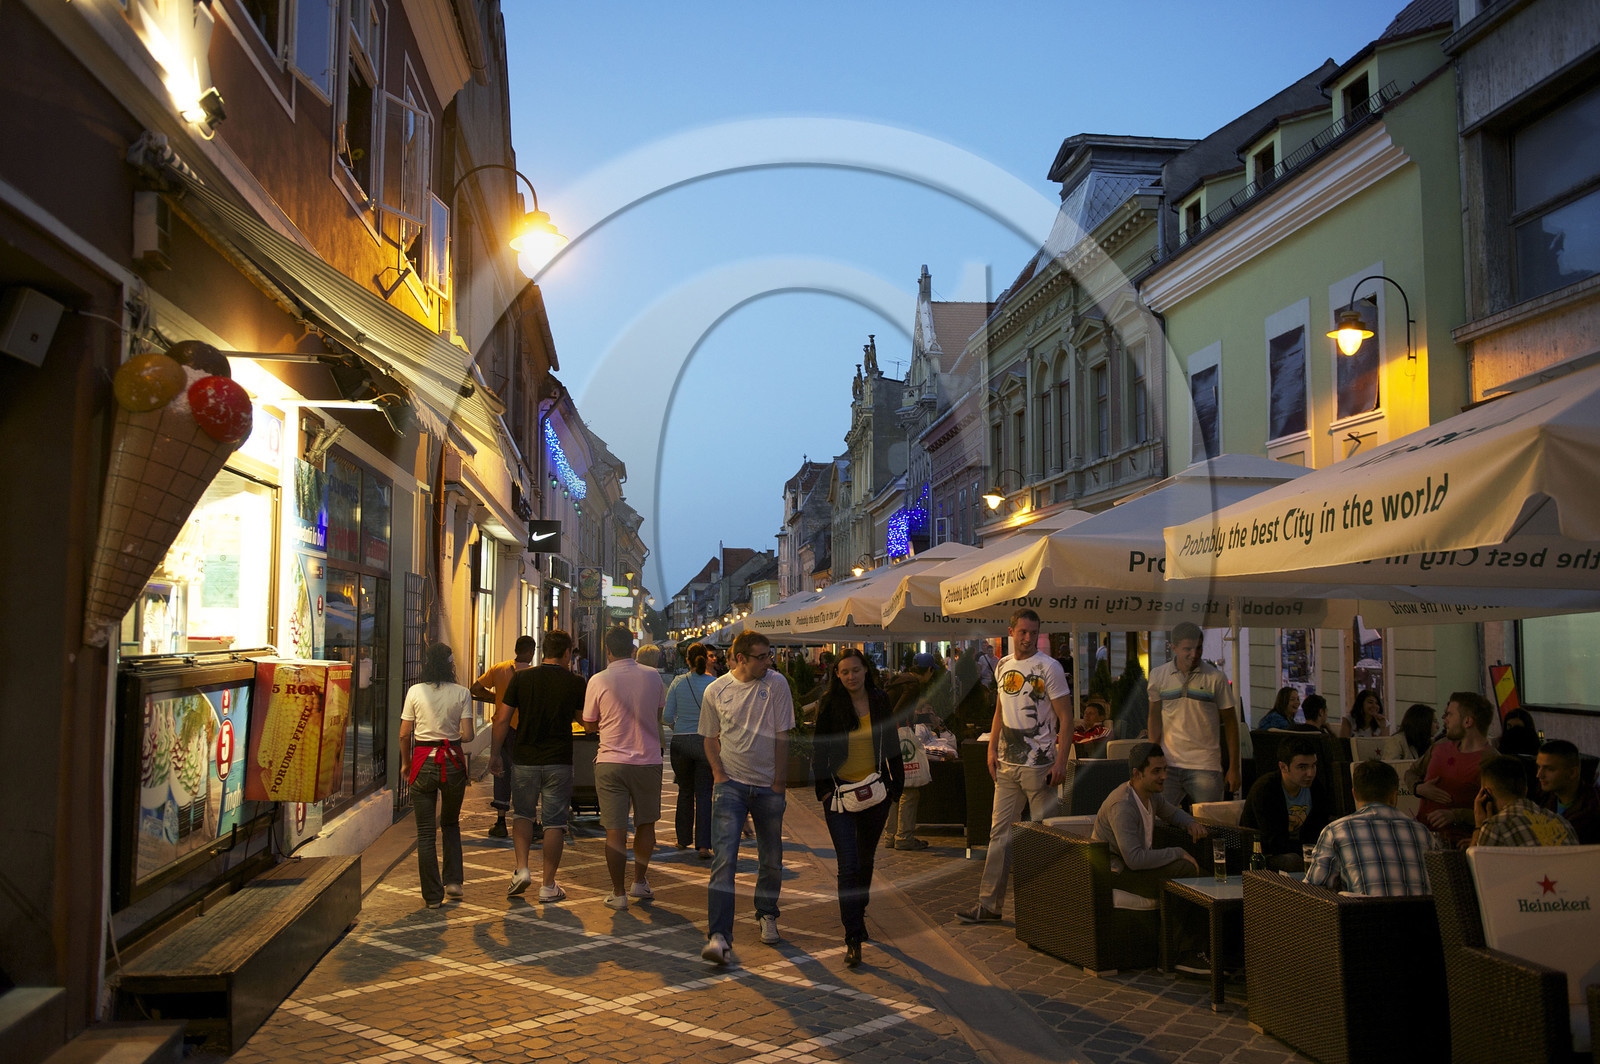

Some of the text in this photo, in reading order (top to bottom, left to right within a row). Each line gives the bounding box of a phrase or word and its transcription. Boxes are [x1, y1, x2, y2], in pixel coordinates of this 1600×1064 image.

[1179, 473, 1449, 558] Probably the best City in the world
[1129, 551, 1166, 573] Pro
[944, 587, 962, 605] Probably
[970, 581, 979, 598] best
[980, 575, 989, 596] City
[990, 573, 996, 591] in
[996, 570, 1005, 588] the
[1006, 561, 1026, 584] world
[754, 619, 775, 629] Probably
[775, 618, 783, 627] the
[272, 684, 321, 696] 5 RON
[221, 724, 230, 762] 5
[271, 706, 313, 794] PORUMB FIERT
[1518, 897, 1590, 913] Heineken
